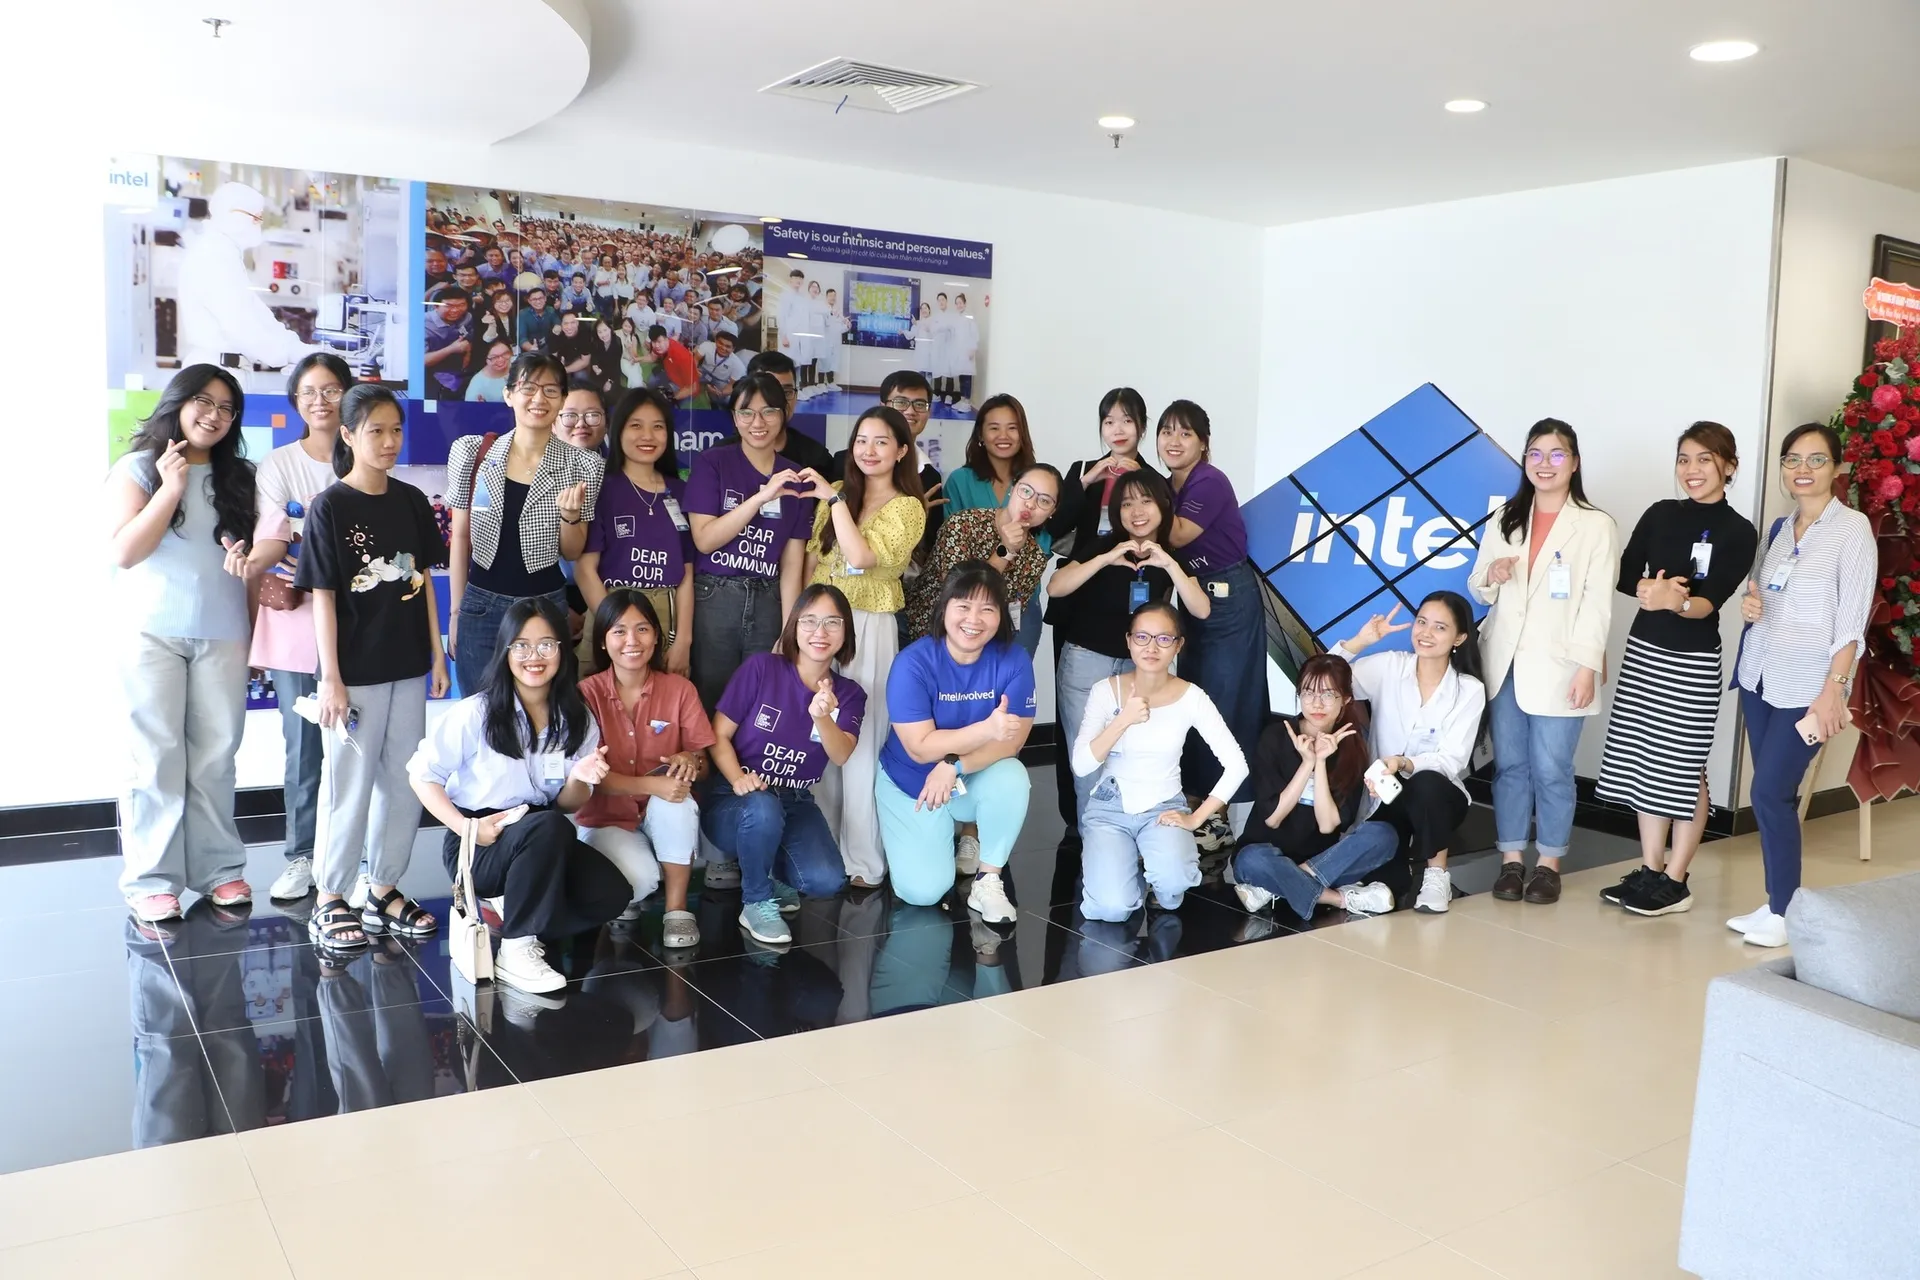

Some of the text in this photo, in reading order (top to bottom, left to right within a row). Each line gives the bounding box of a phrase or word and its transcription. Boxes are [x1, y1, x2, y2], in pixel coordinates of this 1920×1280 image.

[109, 170, 148, 187] intel
[811, 230, 821, 242] is
[822, 234, 841, 244] our
[842, 231, 884, 249] intrinsic
[885, 240, 905, 251] and
[906, 242, 950, 257] personal
[631, 547, 668, 566] DEAR
[738, 540, 767, 559] OUR
[632, 565, 663, 582] OUR
[710, 551, 778, 577] COMMUNI
[763, 743, 807, 765] DEAR
[761, 758, 797, 777] OUR
